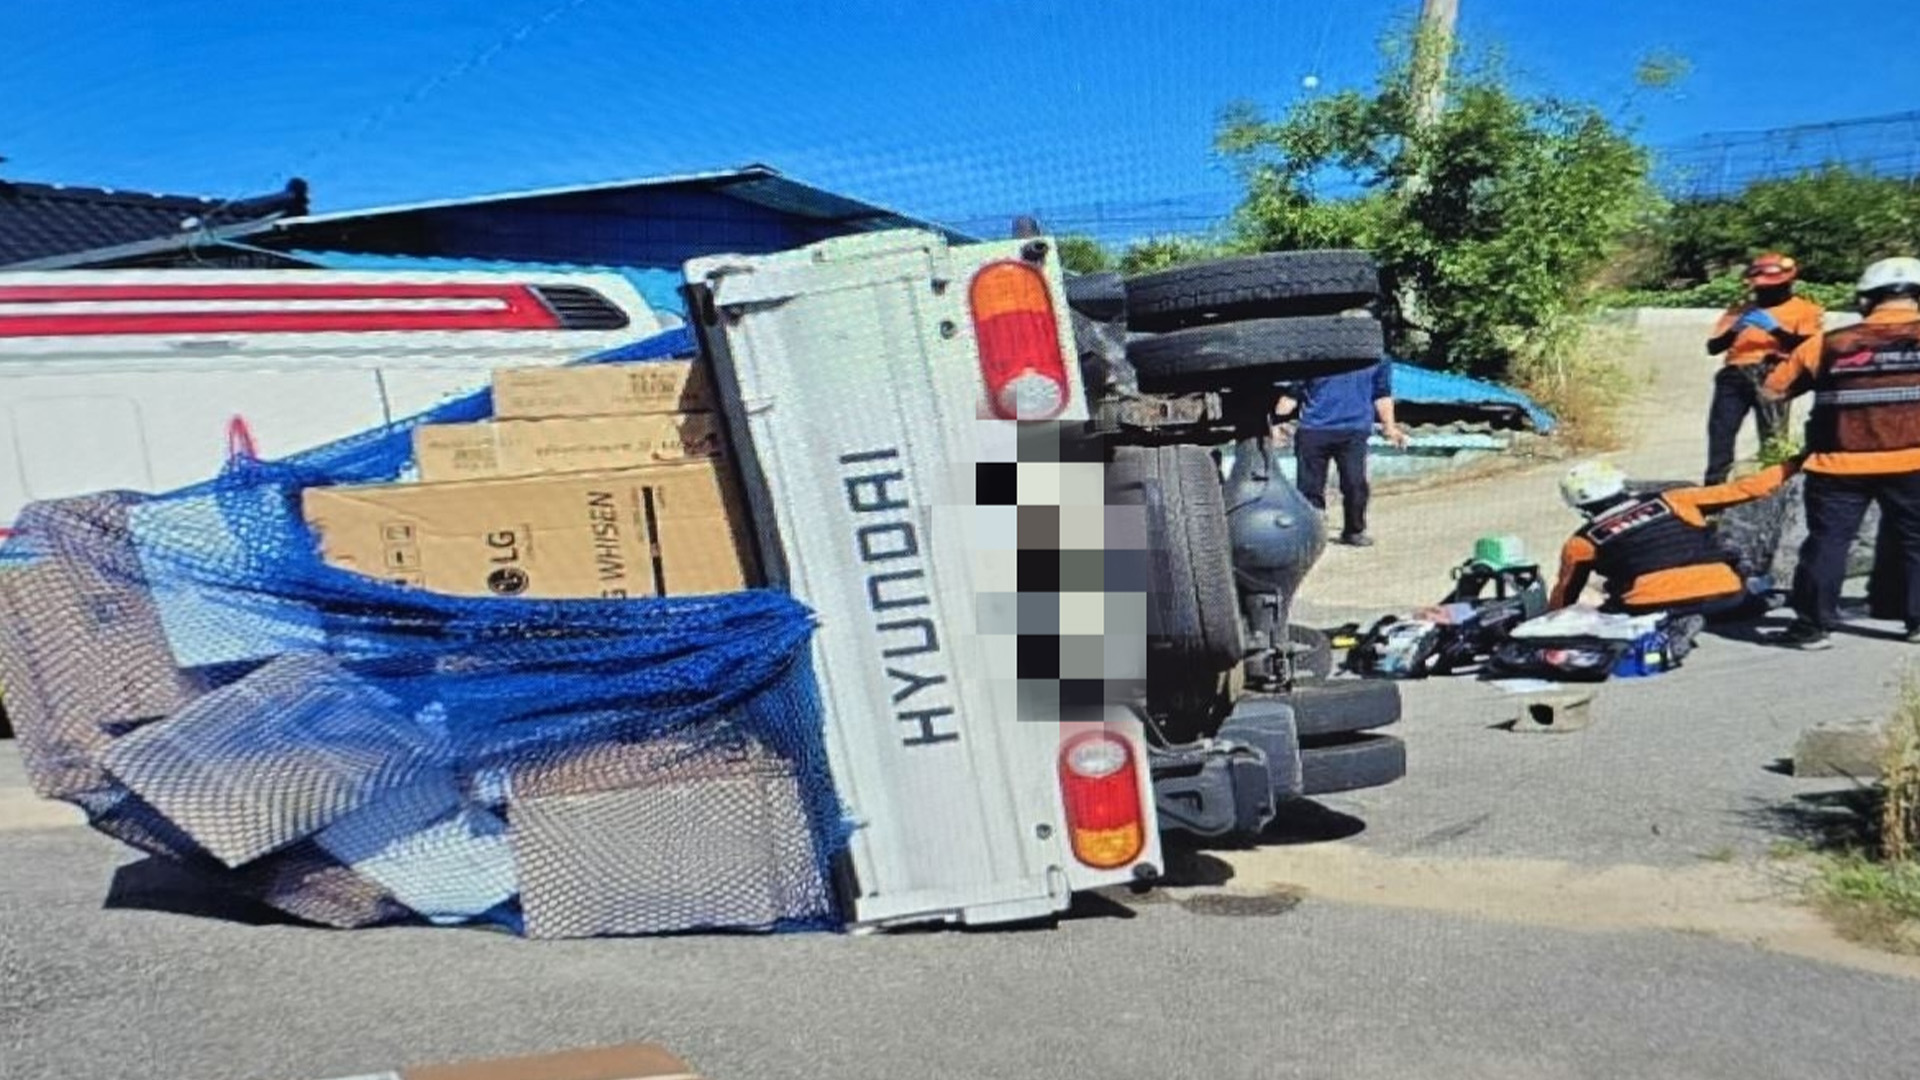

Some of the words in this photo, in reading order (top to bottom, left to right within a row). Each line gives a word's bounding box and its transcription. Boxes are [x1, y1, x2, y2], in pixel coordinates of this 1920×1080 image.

[488, 530, 519, 564] LG
[588, 491, 626, 581] WHISEN
[839, 448, 960, 747] HYUNDAI
